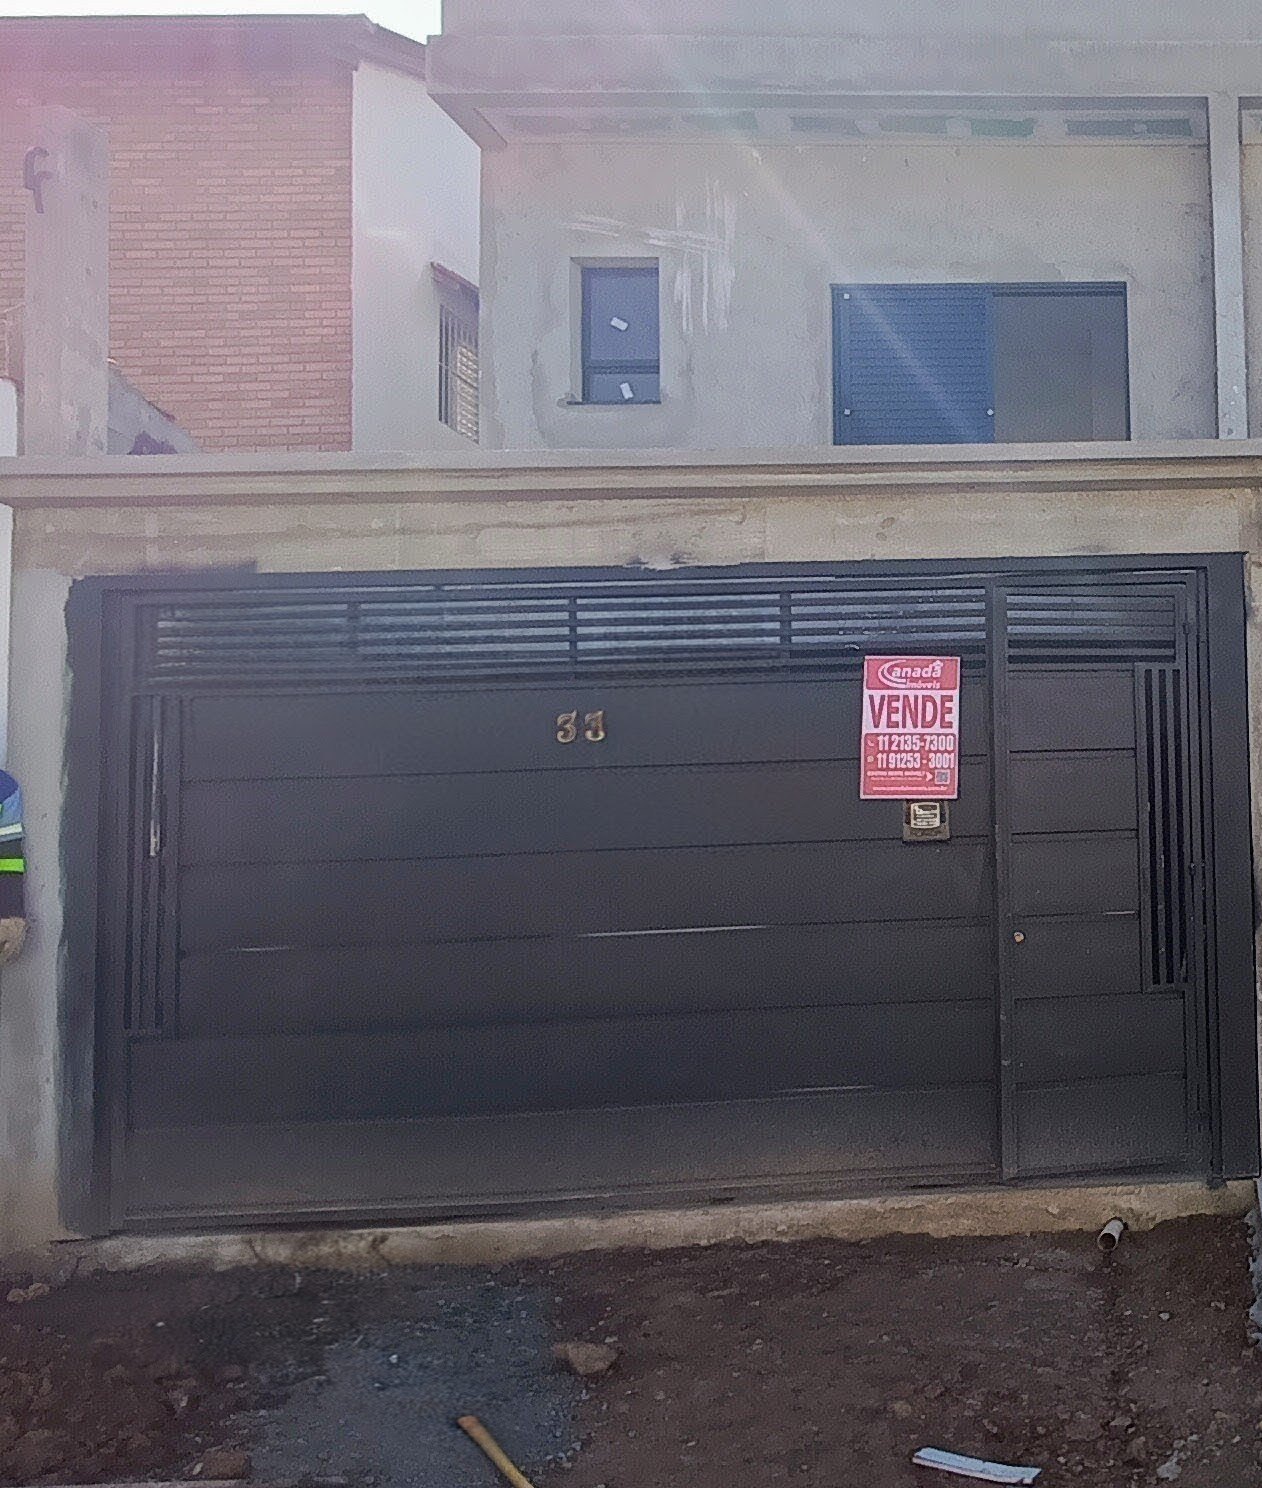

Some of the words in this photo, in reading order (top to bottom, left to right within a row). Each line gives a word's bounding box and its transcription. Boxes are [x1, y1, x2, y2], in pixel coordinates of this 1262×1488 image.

[869, 694, 954, 729] VENDE
[877, 735, 889, 751] 11
[891, 735, 954, 751] 2135-7300
[876, 753, 888, 769] 11
[889, 753, 921, 769] 91253
[928, 753, 955, 769] 3001
